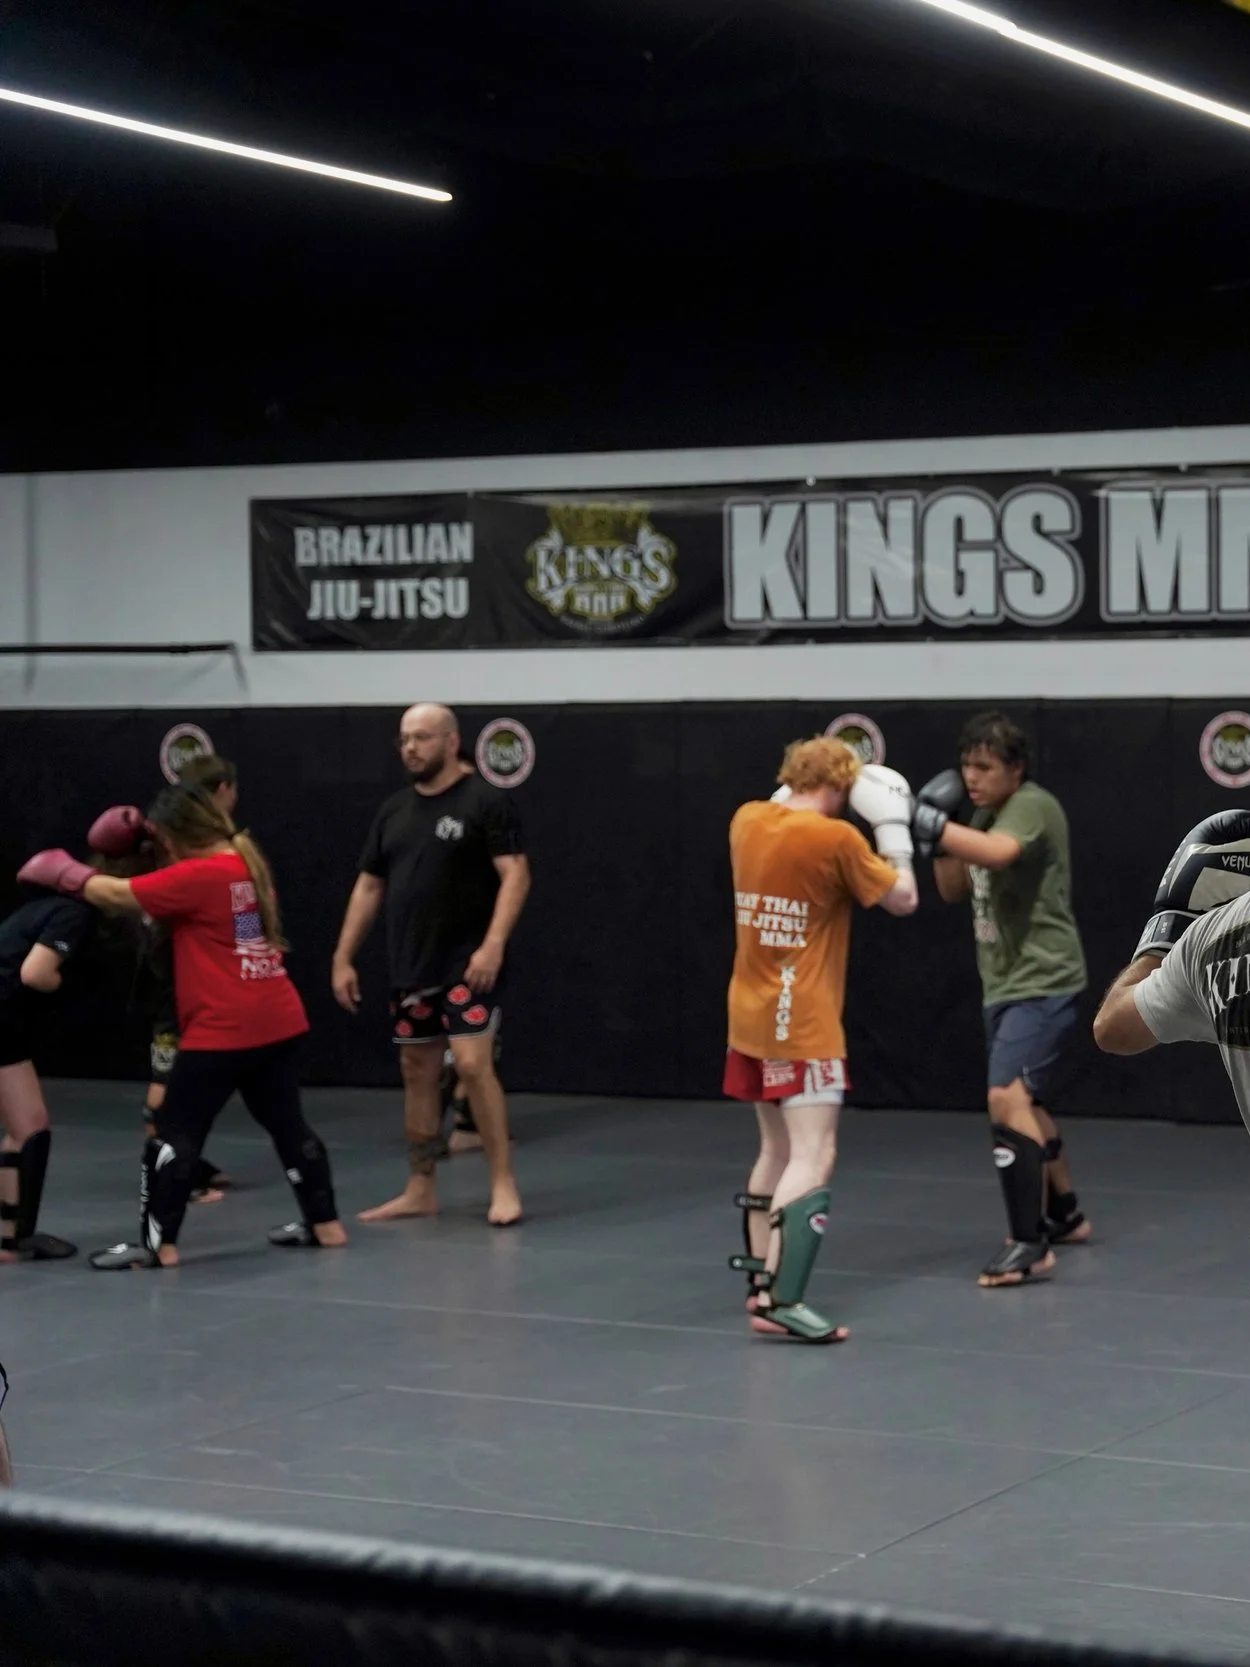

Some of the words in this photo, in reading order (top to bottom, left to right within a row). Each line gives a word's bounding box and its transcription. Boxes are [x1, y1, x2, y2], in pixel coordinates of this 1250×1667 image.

[294, 521, 475, 567] BRAZILIAN
[536, 540, 671, 593] KINGS
[723, 482, 1085, 630] KINGS
[306, 576, 470, 621] JIU-JITSU
[752, 912, 808, 932] JITSU
[762, 895, 809, 917] THAI
[760, 929, 808, 948] MMA
[775, 965, 797, 1041] KINGS
